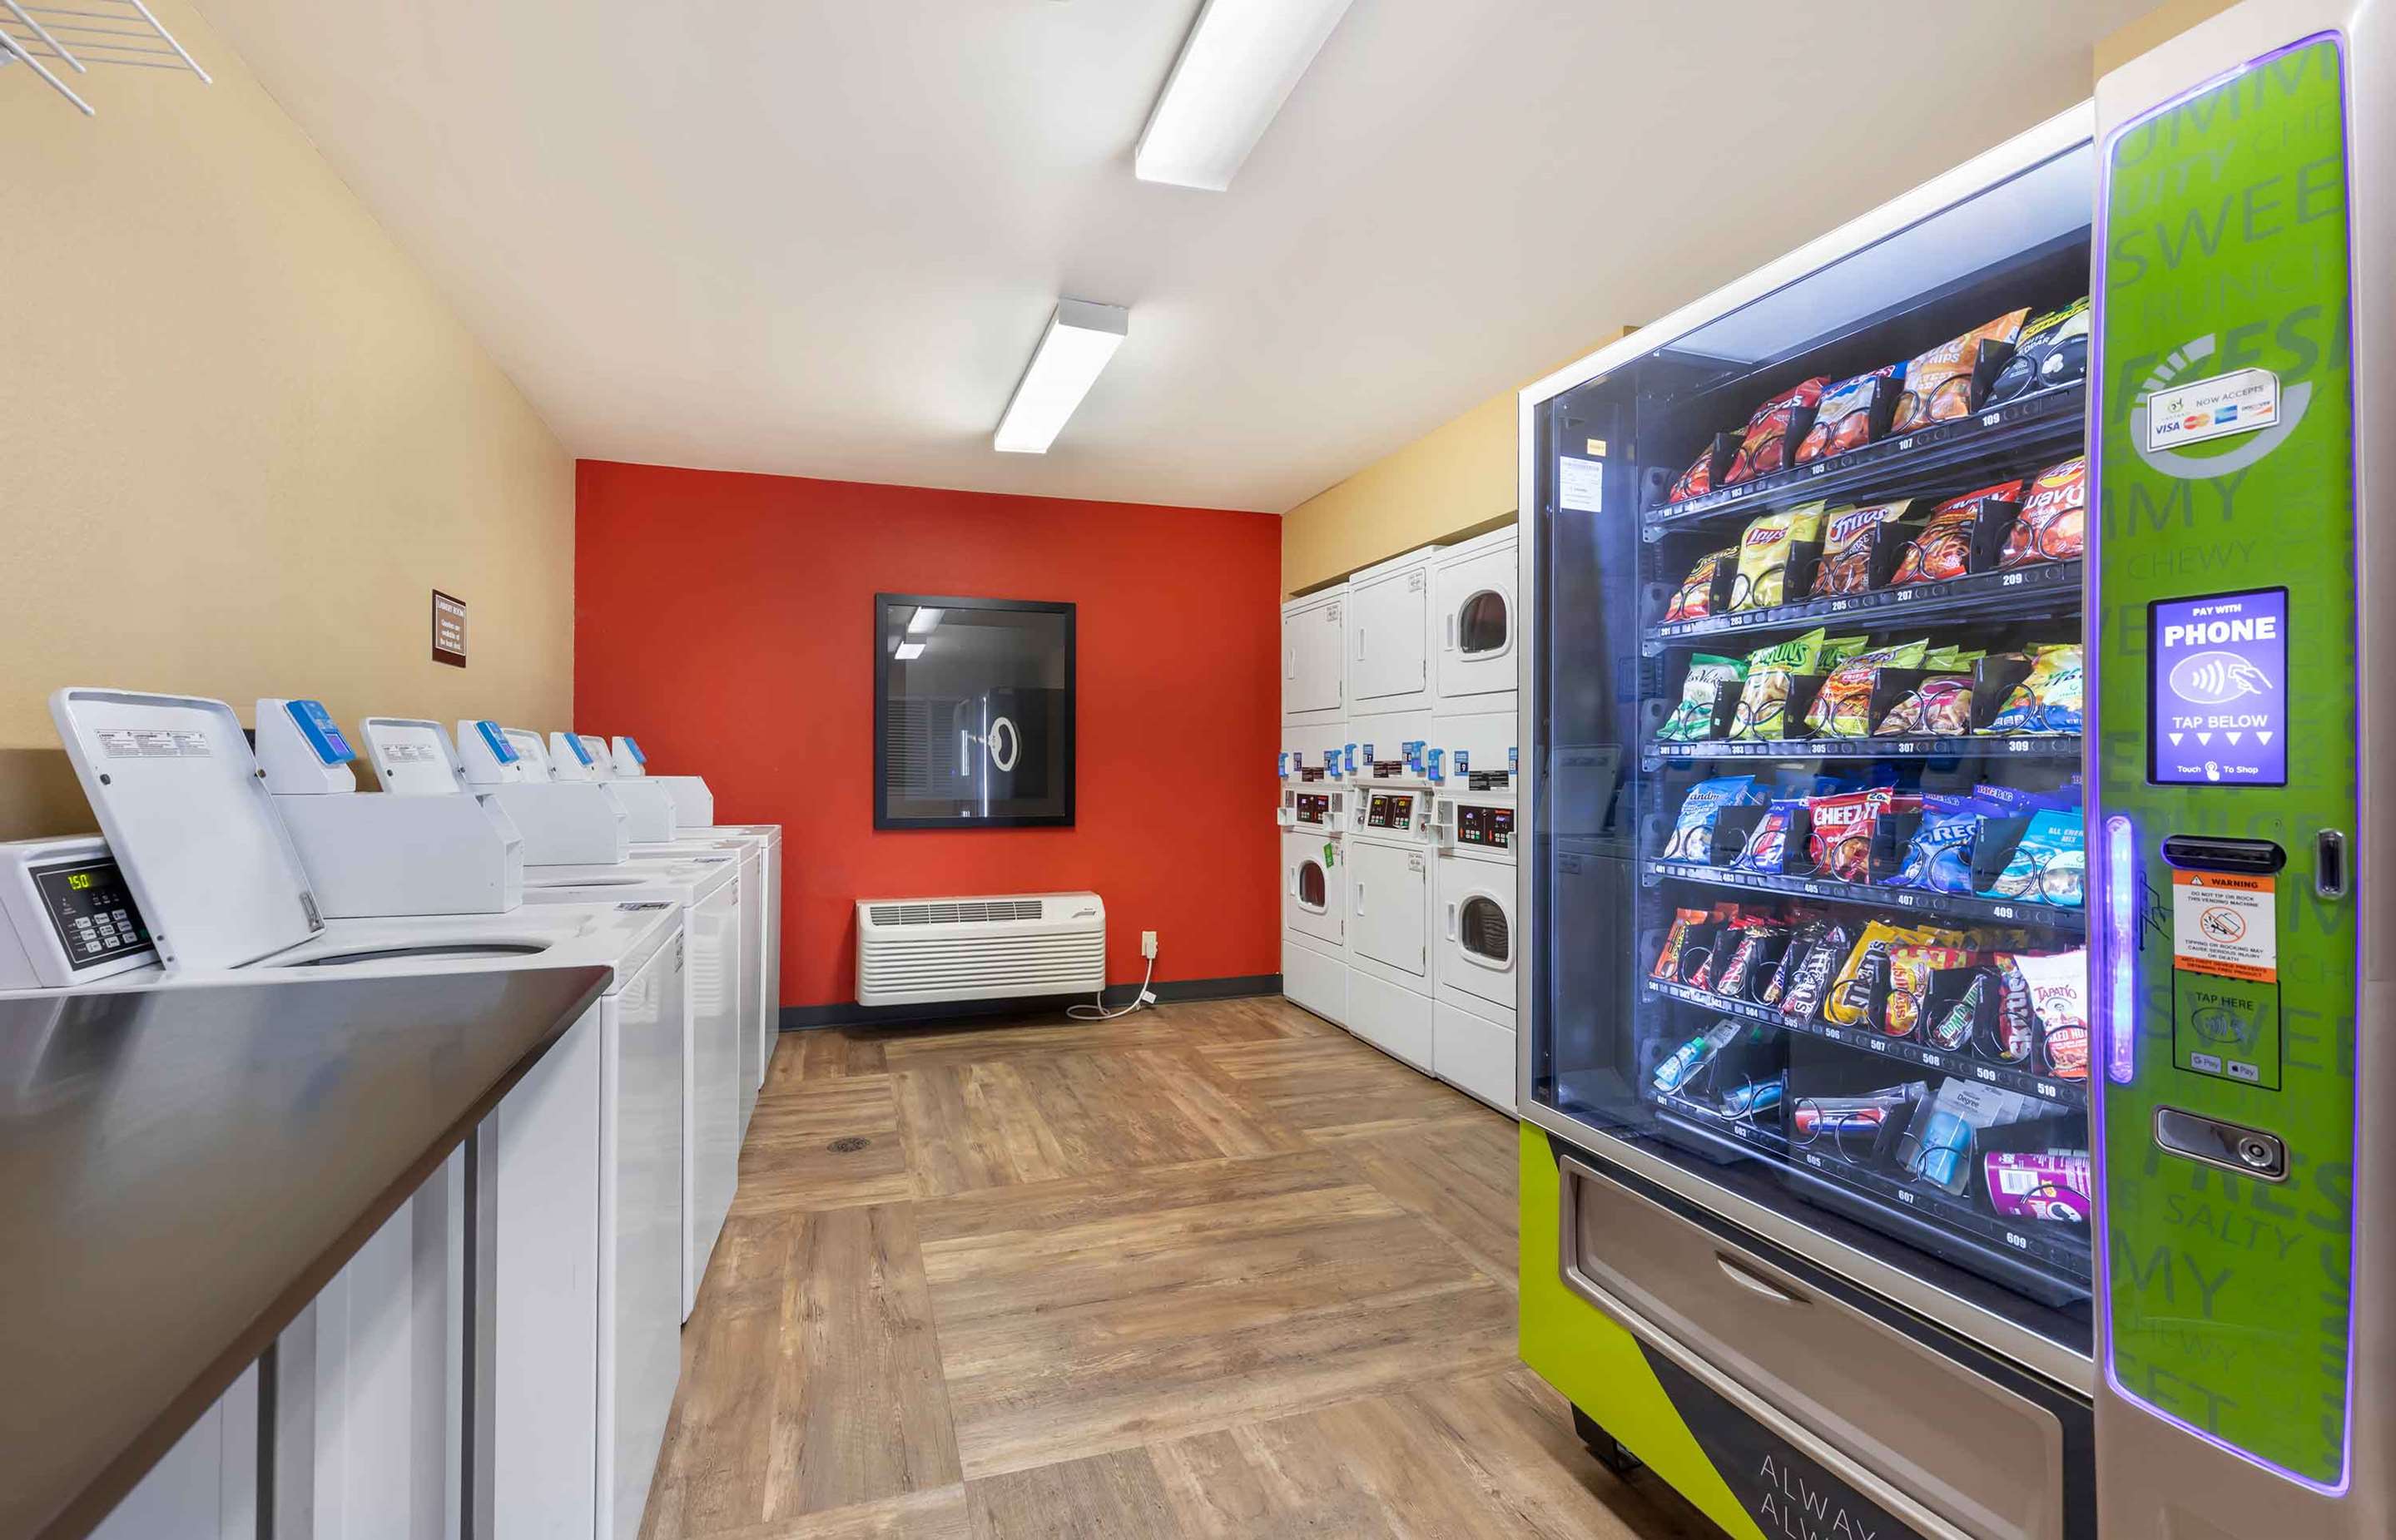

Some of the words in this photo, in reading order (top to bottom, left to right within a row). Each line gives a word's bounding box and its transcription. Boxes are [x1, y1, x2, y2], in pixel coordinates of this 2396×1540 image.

[2196, 396, 2220, 407] NOW
[2222, 384, 2264, 400] ACCEPTS
[1982, 413, 2000, 426] 109
[2156, 422, 2180, 434] VISA
[1898, 438, 1912, 450] 107
[1813, 464, 1824, 474] 105
[1732, 488, 1743, 498] 103
[1830, 508, 1888, 547] Fritos
[1746, 526, 1788, 547] Lay's
[2127, 538, 2258, 580] CHEWY
[2003, 573, 2022, 586] 209
[1897, 591, 1912, 601] 207
[1832, 601, 1847, 611] 205
[2192, 606, 2214, 616] PAY
[2215, 604, 2241, 615] WITH
[1731, 616, 1743, 625] 203
[2165, 616, 2276, 647] PHONE
[2172, 716, 2203, 729] TAP
[2208, 715, 2268, 729] BELOW
[1812, 744, 1826, 753] 305
[1898, 743, 1914, 752] 307
[2009, 741, 2029, 752] 309
[2177, 765, 2201, 774] Touch
[2223, 765, 2234, 774] To
[2236, 765, 2259, 775] Shop
[1804, 884, 1818, 894] 405
[2210, 879, 2258, 889] WARNING
[1898, 894, 1913, 906] 407
[1993, 907, 2013, 919] 409
[2220, 943, 2249, 952] ROCKING
[2034, 984, 2078, 1002] TAPATÍO
[2196, 992, 2218, 1003] TAP
[2221, 997, 2254, 1011] HERE
[1745, 1007, 1759, 1018] 504
[1784, 1018, 1798, 1028] 505
[1825, 1027, 1840, 1038] 506
[1871, 1040, 1886, 1051] 507
[1922, 1053, 1940, 1066] 508
[2204, 1057, 2219, 1069] Pay
[1977, 1067, 1996, 1080] 509
[2240, 1066, 2255, 1077] Pay
[2037, 1083, 2056, 1097] 510
[1957, 1093, 1980, 1108] Degree
[1734, 1127, 1747, 1136] 603
[1806, 1154, 1821, 1166] 605
[1898, 1190, 1914, 1204] 607
[2165, 1194, 2304, 1260] SALTY
[2007, 1232, 2026, 1248] 609
